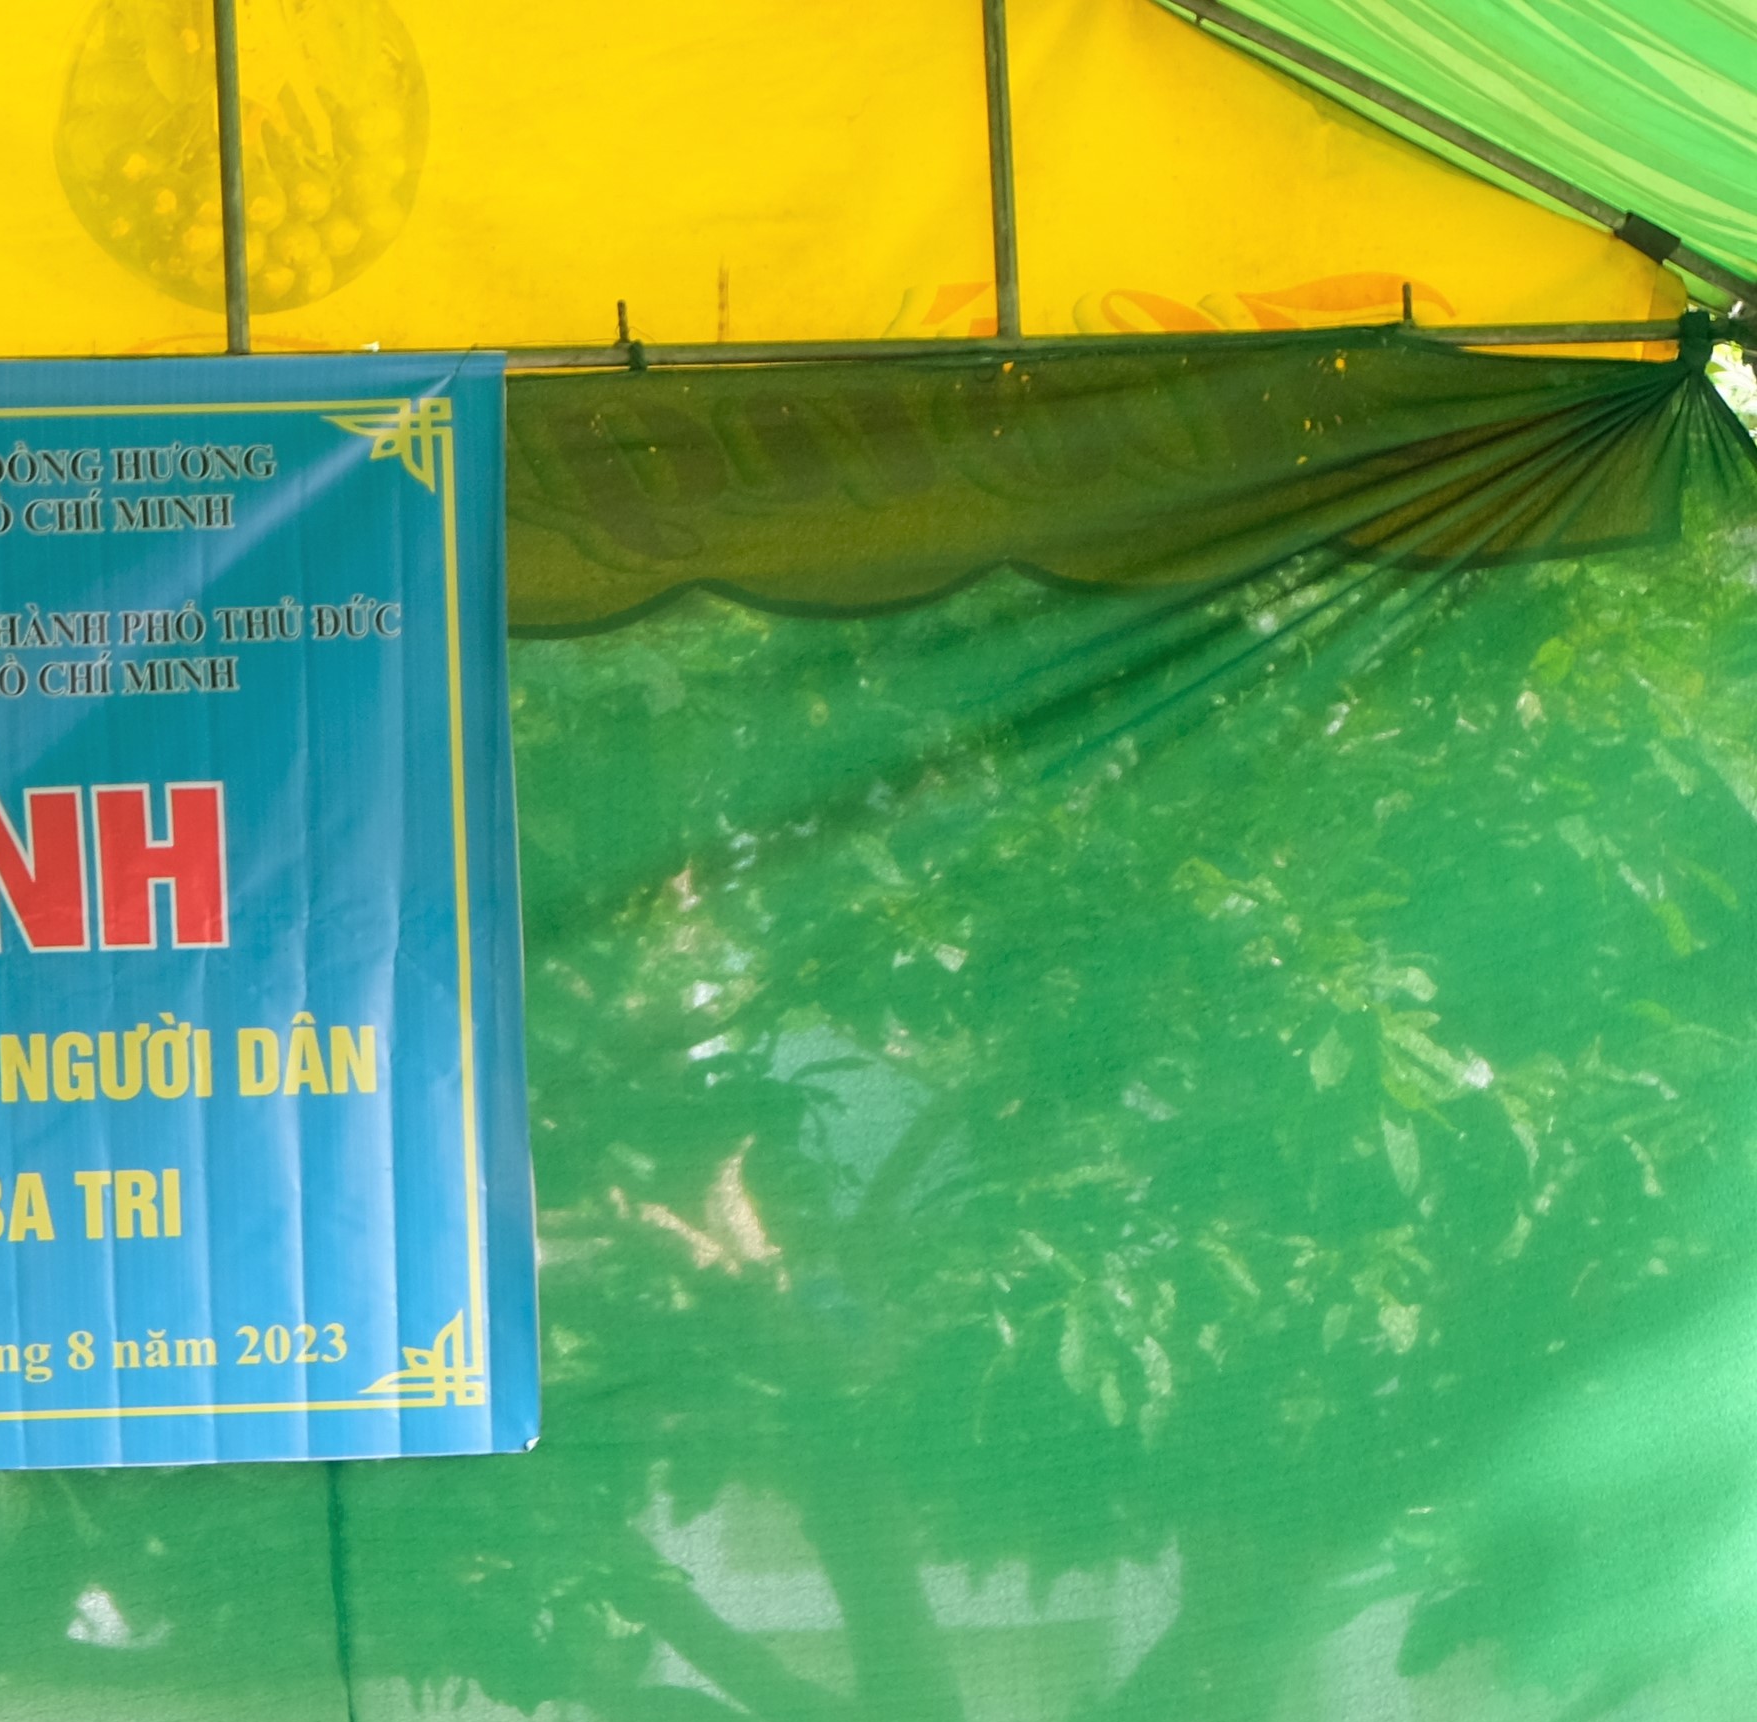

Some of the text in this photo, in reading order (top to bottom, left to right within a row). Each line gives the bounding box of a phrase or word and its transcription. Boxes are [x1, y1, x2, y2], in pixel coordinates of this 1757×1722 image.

[112, 445, 277, 485] HƯƠNG
[23, 491, 102, 536] CHÍ
[112, 494, 236, 533] MINH
[121, 601, 207, 647] PHỐ
[216, 595, 303, 644] THỦ
[312, 596, 403, 642] ĐỨC
[38, 650, 113, 698] CHÍ
[121, 656, 239, 696] MINH
[0, 1013, 213, 1104] NGƯỜI
[237, 1012, 378, 1097] DÂN
[75, 1169, 183, 1241] TRI
[67, 1331, 96, 1370] 8
[112, 1328, 218, 1370] năm
[235, 1322, 348, 1366] 2023
